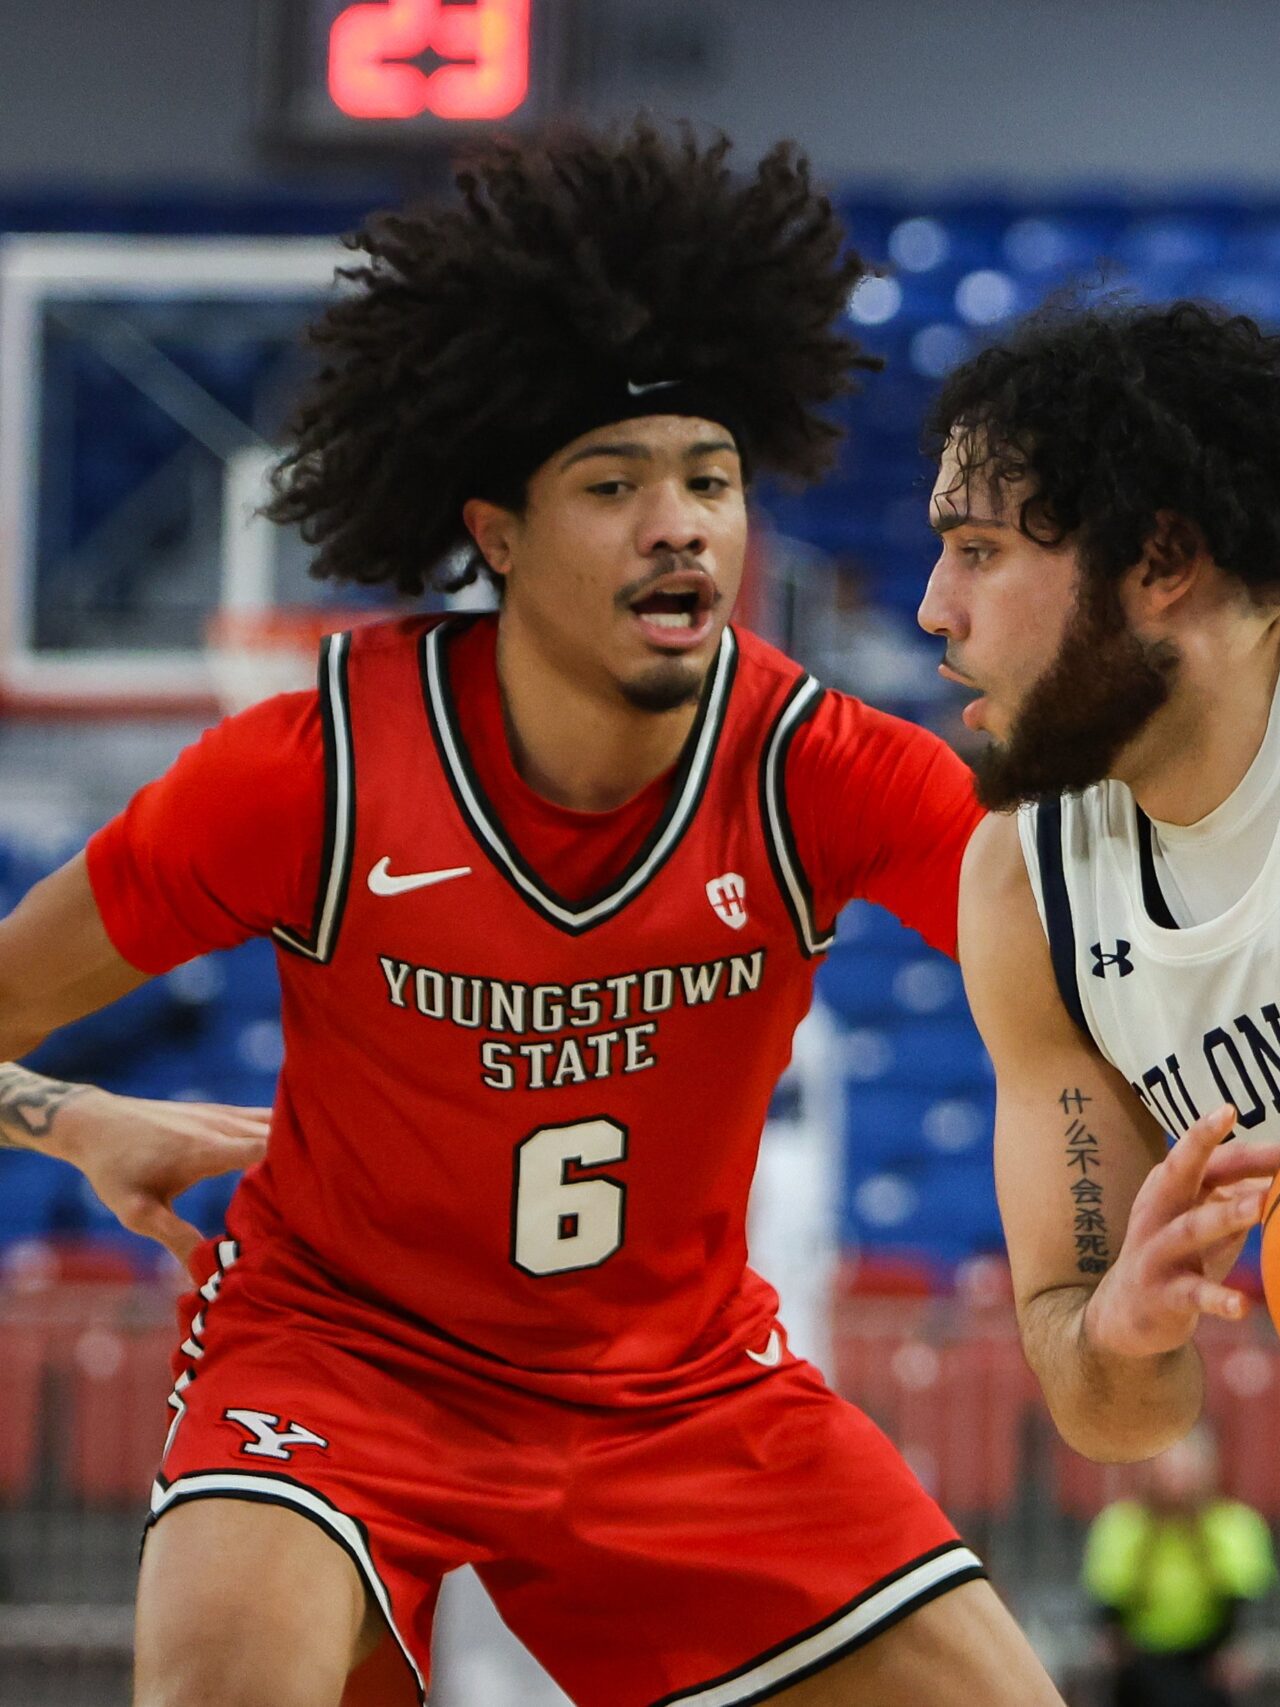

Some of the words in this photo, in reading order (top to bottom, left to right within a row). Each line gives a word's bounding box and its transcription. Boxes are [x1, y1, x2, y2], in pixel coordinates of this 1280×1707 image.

[379, 950, 766, 1034] YOUNGSTOWN
[480, 1022, 657, 1090] STATE
[509, 1114, 629, 1279] 6
[222, 1407, 329, 1462] Y
